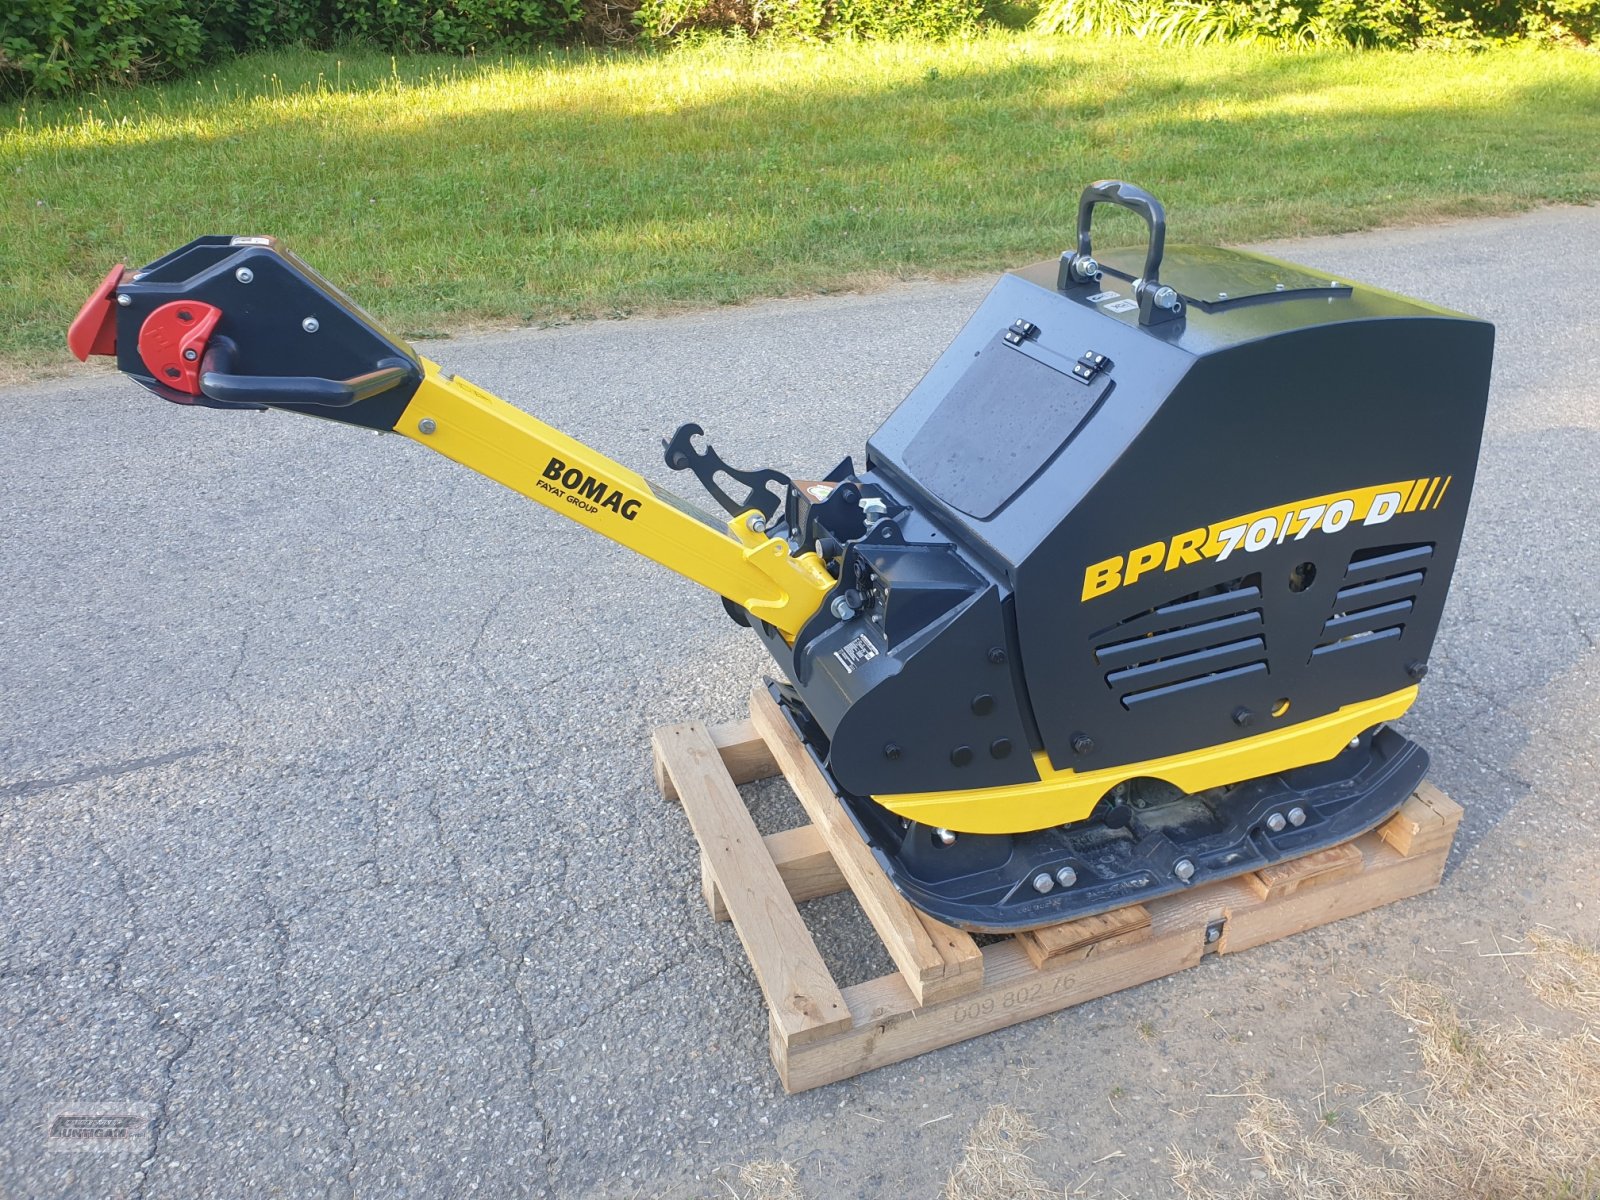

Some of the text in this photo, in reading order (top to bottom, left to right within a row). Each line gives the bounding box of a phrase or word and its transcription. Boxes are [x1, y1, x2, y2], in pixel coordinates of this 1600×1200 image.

[536, 479, 598, 514] FAYAT GROUP
[542, 457, 642, 521] BOMAG
[1081, 491, 1402, 602] BPR 70/70 D
[1003, 983, 1043, 1009] 802
[1052, 973, 1076, 994] 76
